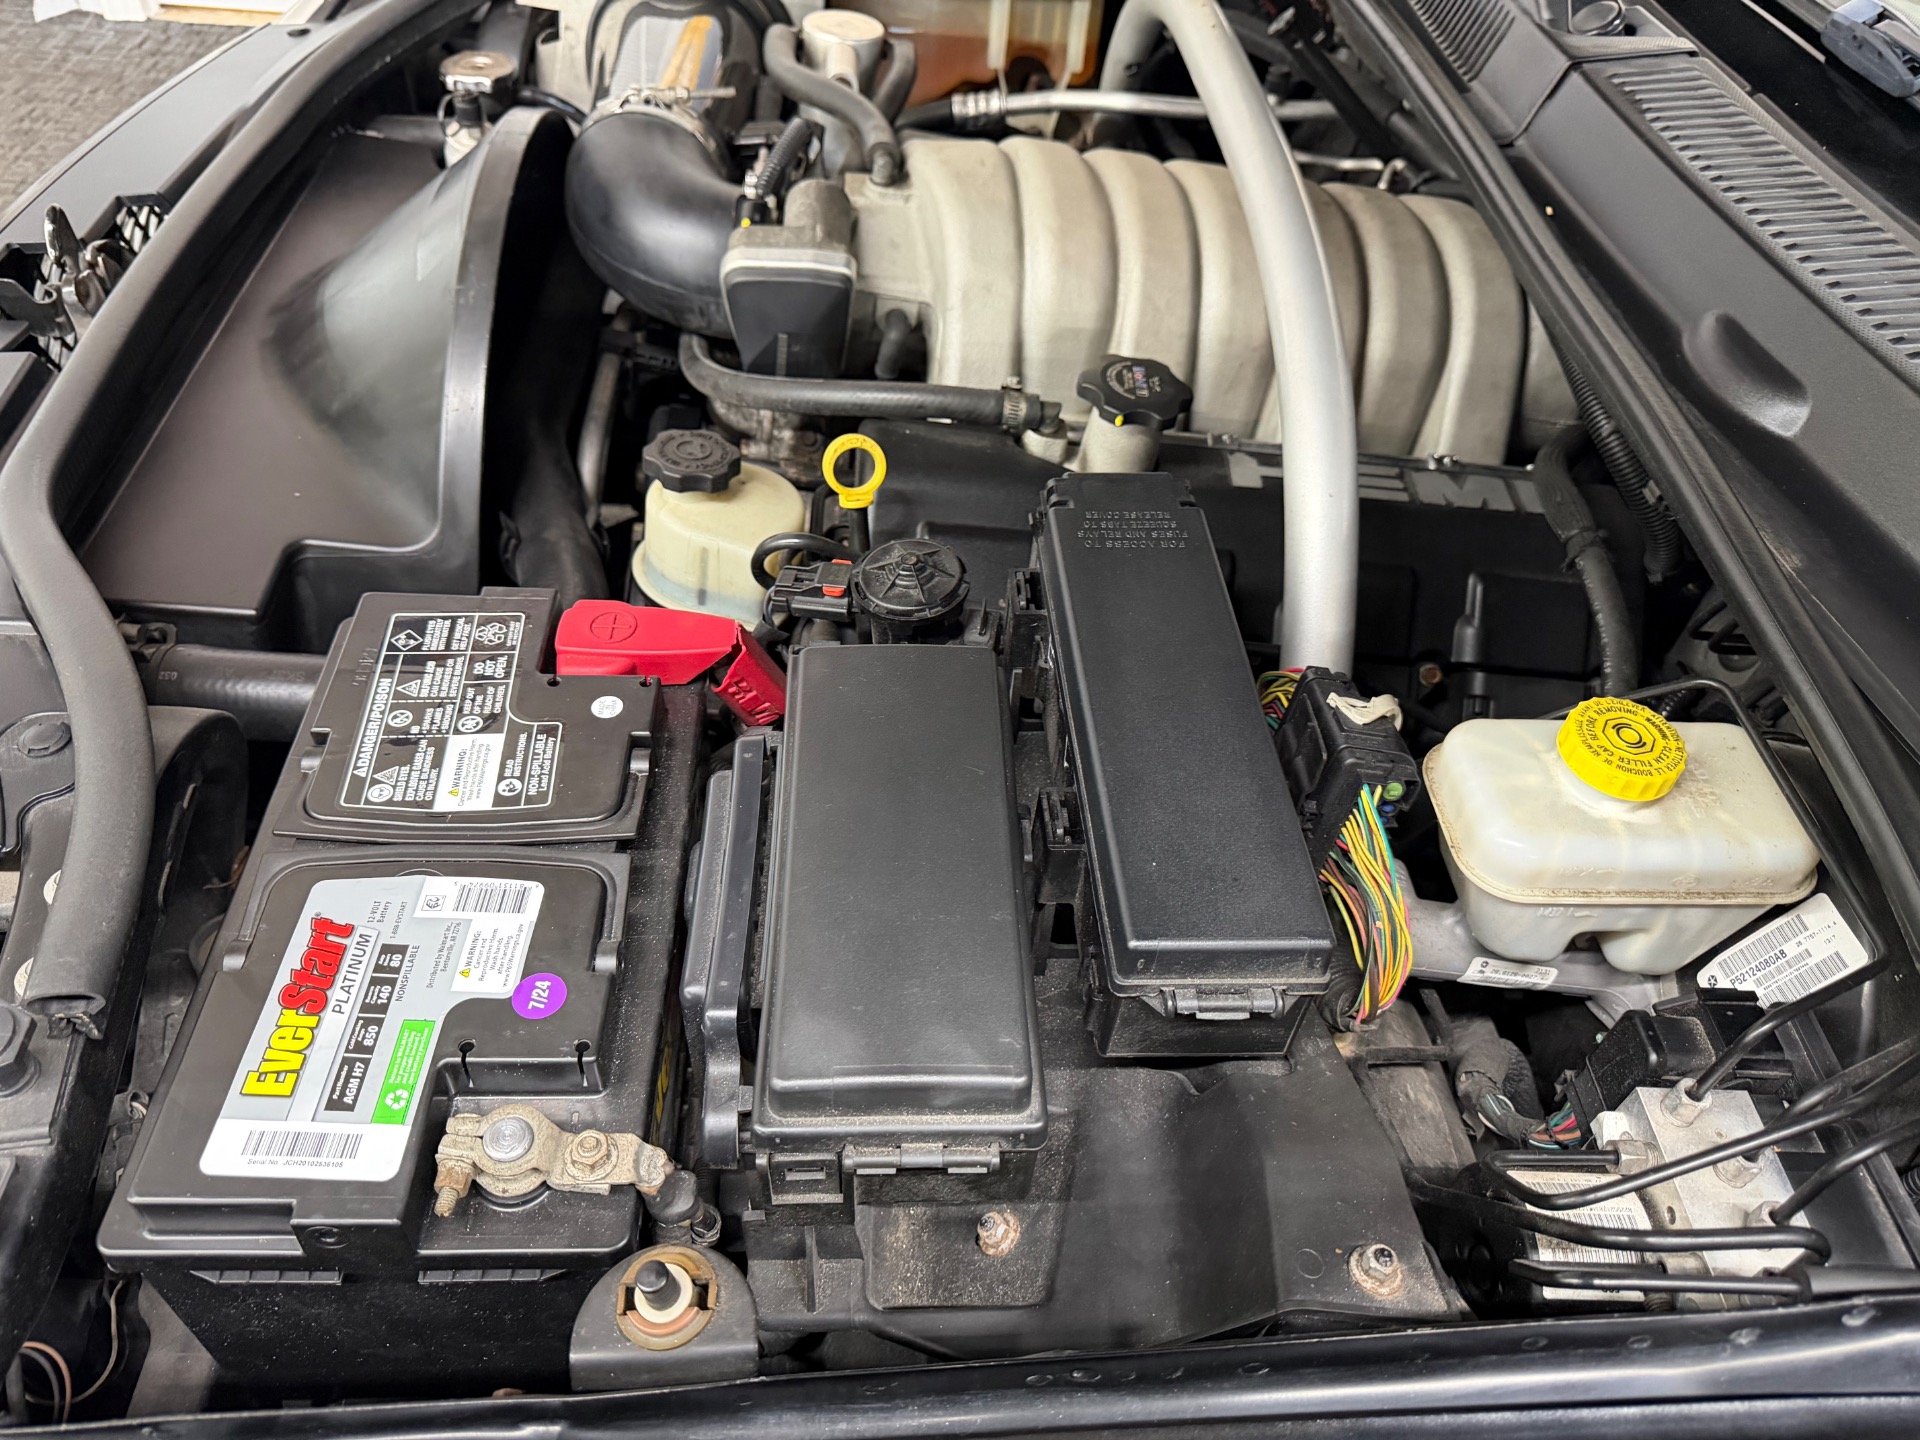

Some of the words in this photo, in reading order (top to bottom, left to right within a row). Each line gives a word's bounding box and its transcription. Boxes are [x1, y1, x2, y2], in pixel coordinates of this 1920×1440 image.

[1084, 520, 1098, 528] TO
[1100, 520, 1128, 528] TABS
[1130, 520, 1176, 528] SQUEEZE
[1078, 530, 1122, 538] RELAYS
[1124, 530, 1146, 538] AND
[1151, 530, 1188, 538] FUSES
[1084, 540, 1102, 548] TO
[1106, 540, 1155, 548] ACCESS
[1160, 540, 1186, 548] FOR
[473, 662, 485, 674] DO
[483, 660, 496, 675] NOT
[465, 687, 476, 699] OUT
[463, 700, 473, 714] KEEP
[1594, 705, 1639, 717] REMOVING
[358, 678, 392, 766] DANGER/POISON
[1586, 715, 1599, 741] BEFORE
[544, 737, 556, 758] Battery
[1596, 744, 1614, 756] CAP
[1653, 745, 1672, 765] CLEAN
[451, 748, 467, 788] WARNING:
[504, 759, 514, 776] READ
[527, 734, 546, 795] NON-SPILLABLE
[542, 760, 552, 774] Acid
[1602, 758, 1613, 766] DE
[1618, 756, 1653, 768] FILLER
[1616, 764, 1654, 776] BOUCHON
[1655, 768, 1666, 776] LE
[539, 775, 549, 791] Lead
[367, 901, 382, 923] 12-VOLT
[376, 901, 392, 923] Battery
[464, 930, 482, 967] WARNING:
[390, 954, 402, 968] 80
[474, 949, 482, 968] Cancer
[331, 933, 373, 1014] PLATINUM
[395, 945, 420, 1002] NONSPILLABLE
[1729, 948, 1788, 988] P52124080AB
[377, 985, 392, 1004] 140
[528, 980, 552, 1010] 7/24
[240, 916, 354, 1098] EverStart
[363, 1025, 378, 1046] 850
[332, 1086, 341, 1099] Part
[337, 1065, 348, 1086] Number
[343, 1078, 360, 1104] AGM
[352, 1062, 365, 1077] H7
